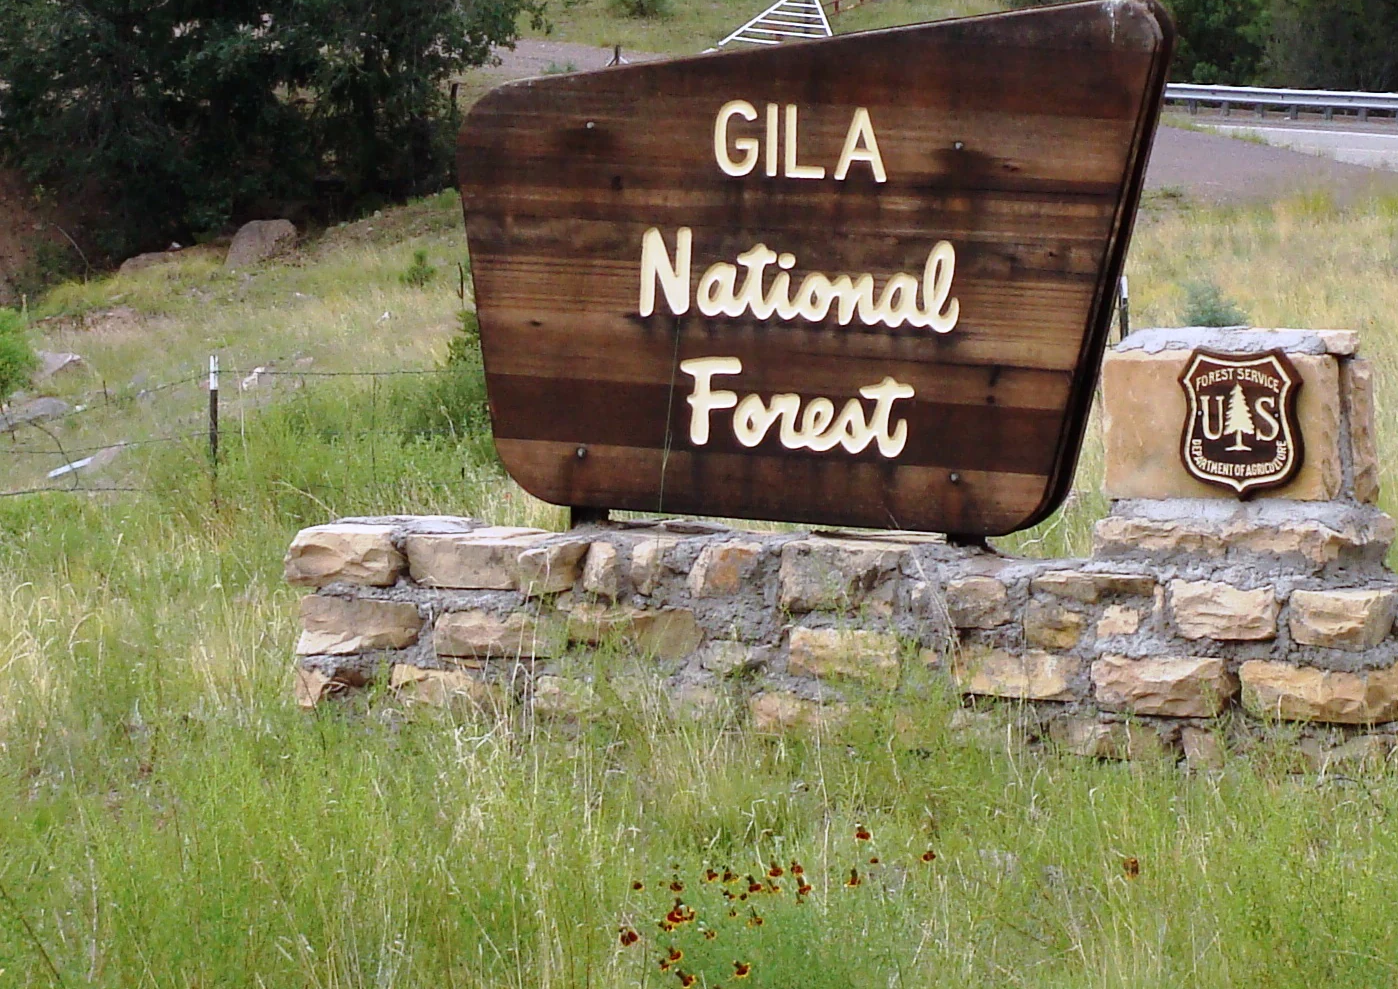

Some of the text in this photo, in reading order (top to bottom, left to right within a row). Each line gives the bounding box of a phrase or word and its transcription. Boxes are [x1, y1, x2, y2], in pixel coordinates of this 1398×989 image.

[714, 99, 886, 183] GILA
[639, 226, 960, 334] National
[681, 356, 915, 458] Forest
[1196, 367, 1280, 394] FOREST SERVICE
[1199, 395, 1280, 441] U S
[1191, 438, 1288, 477] DEPARTMENT OF AGRICULTURE
